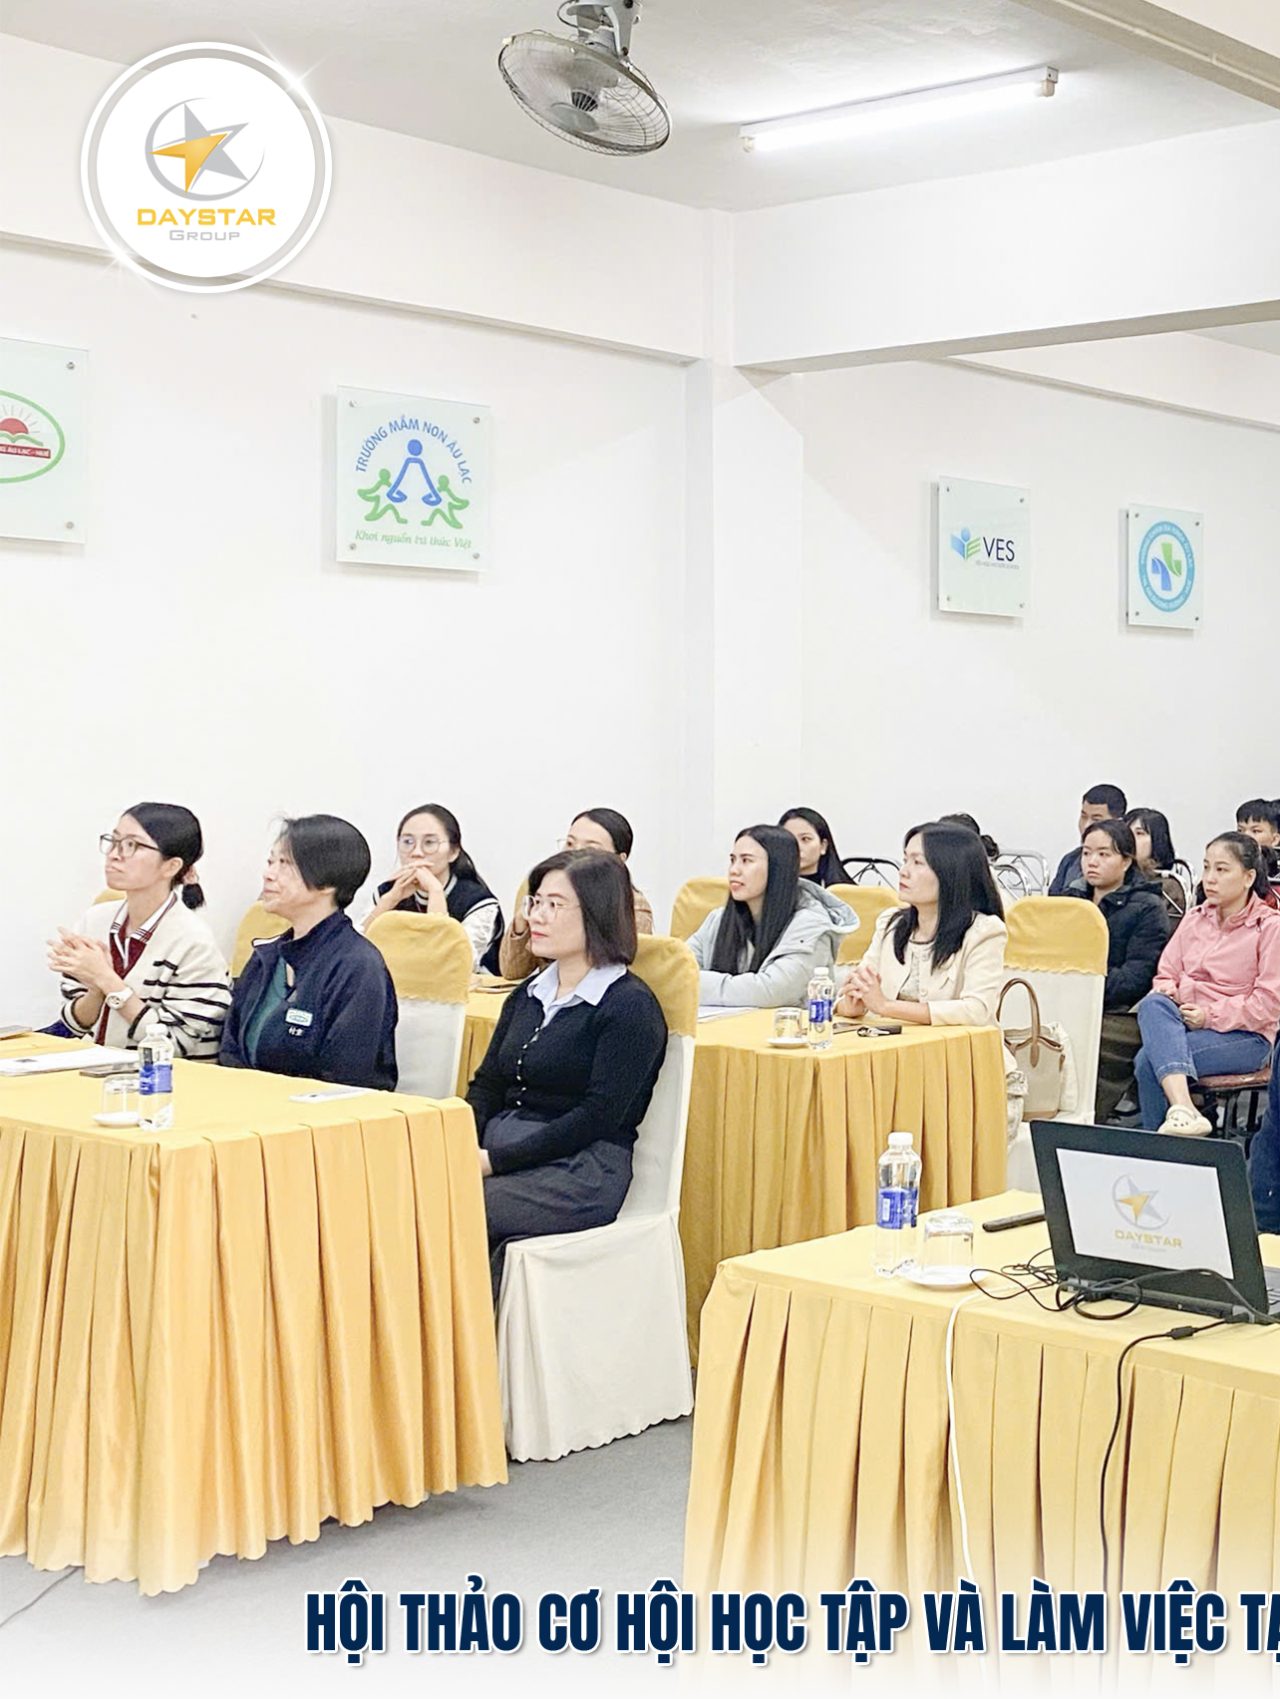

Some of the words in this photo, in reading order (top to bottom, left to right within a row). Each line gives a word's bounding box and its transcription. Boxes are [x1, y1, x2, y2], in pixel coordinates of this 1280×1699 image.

[422, 421, 448, 443] NON
[983, 536, 1015, 562] VES
[1114, 1229, 1183, 1248] DAYSTAR
